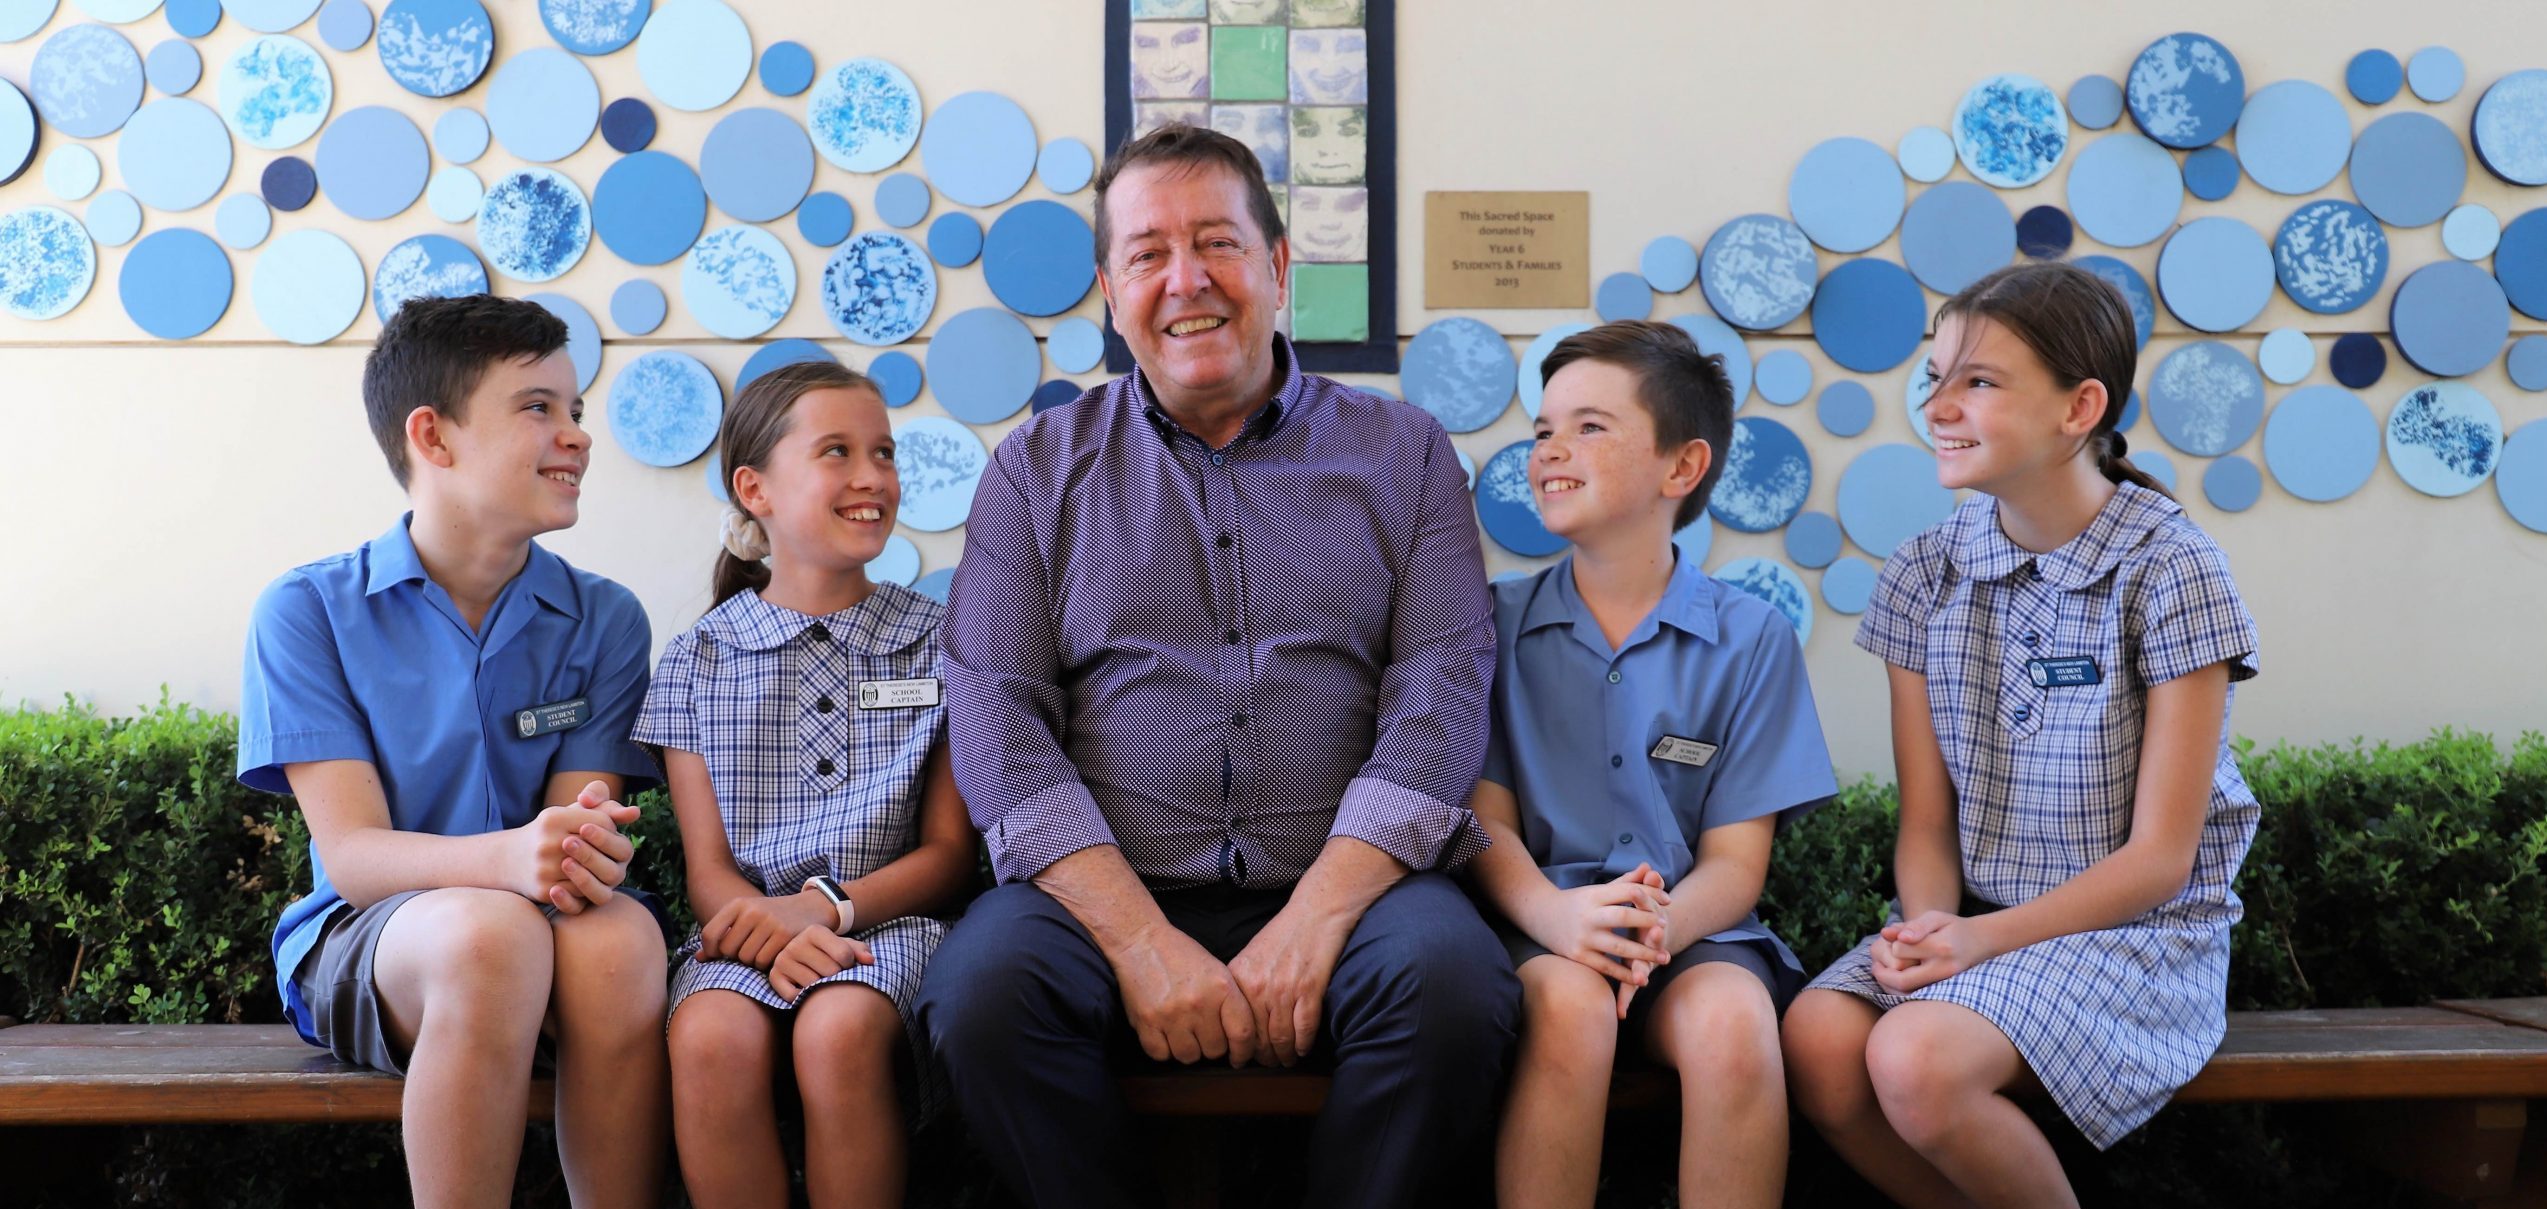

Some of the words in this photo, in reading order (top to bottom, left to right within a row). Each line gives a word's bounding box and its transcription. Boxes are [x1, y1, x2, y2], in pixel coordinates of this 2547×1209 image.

[1459, 211, 1481, 221] This
[1484, 210, 1520, 221] Sacred
[1523, 211, 1555, 223] Space
[1479, 226, 1520, 236] donated
[1523, 226, 1535, 237] by
[1489, 244, 1516, 254] YEAR
[1518, 244, 1525, 254] 6
[1452, 260, 1503, 271] STUDENTS
[1505, 260, 1514, 271] &
[1517, 260, 1562, 271] FAMILIES
[1495, 277, 1520, 288] 2013
[891, 695, 924, 703] CAPTAIN
[547, 709, 576, 721] STUDENT
[548, 716, 577, 727] COUNCIL
